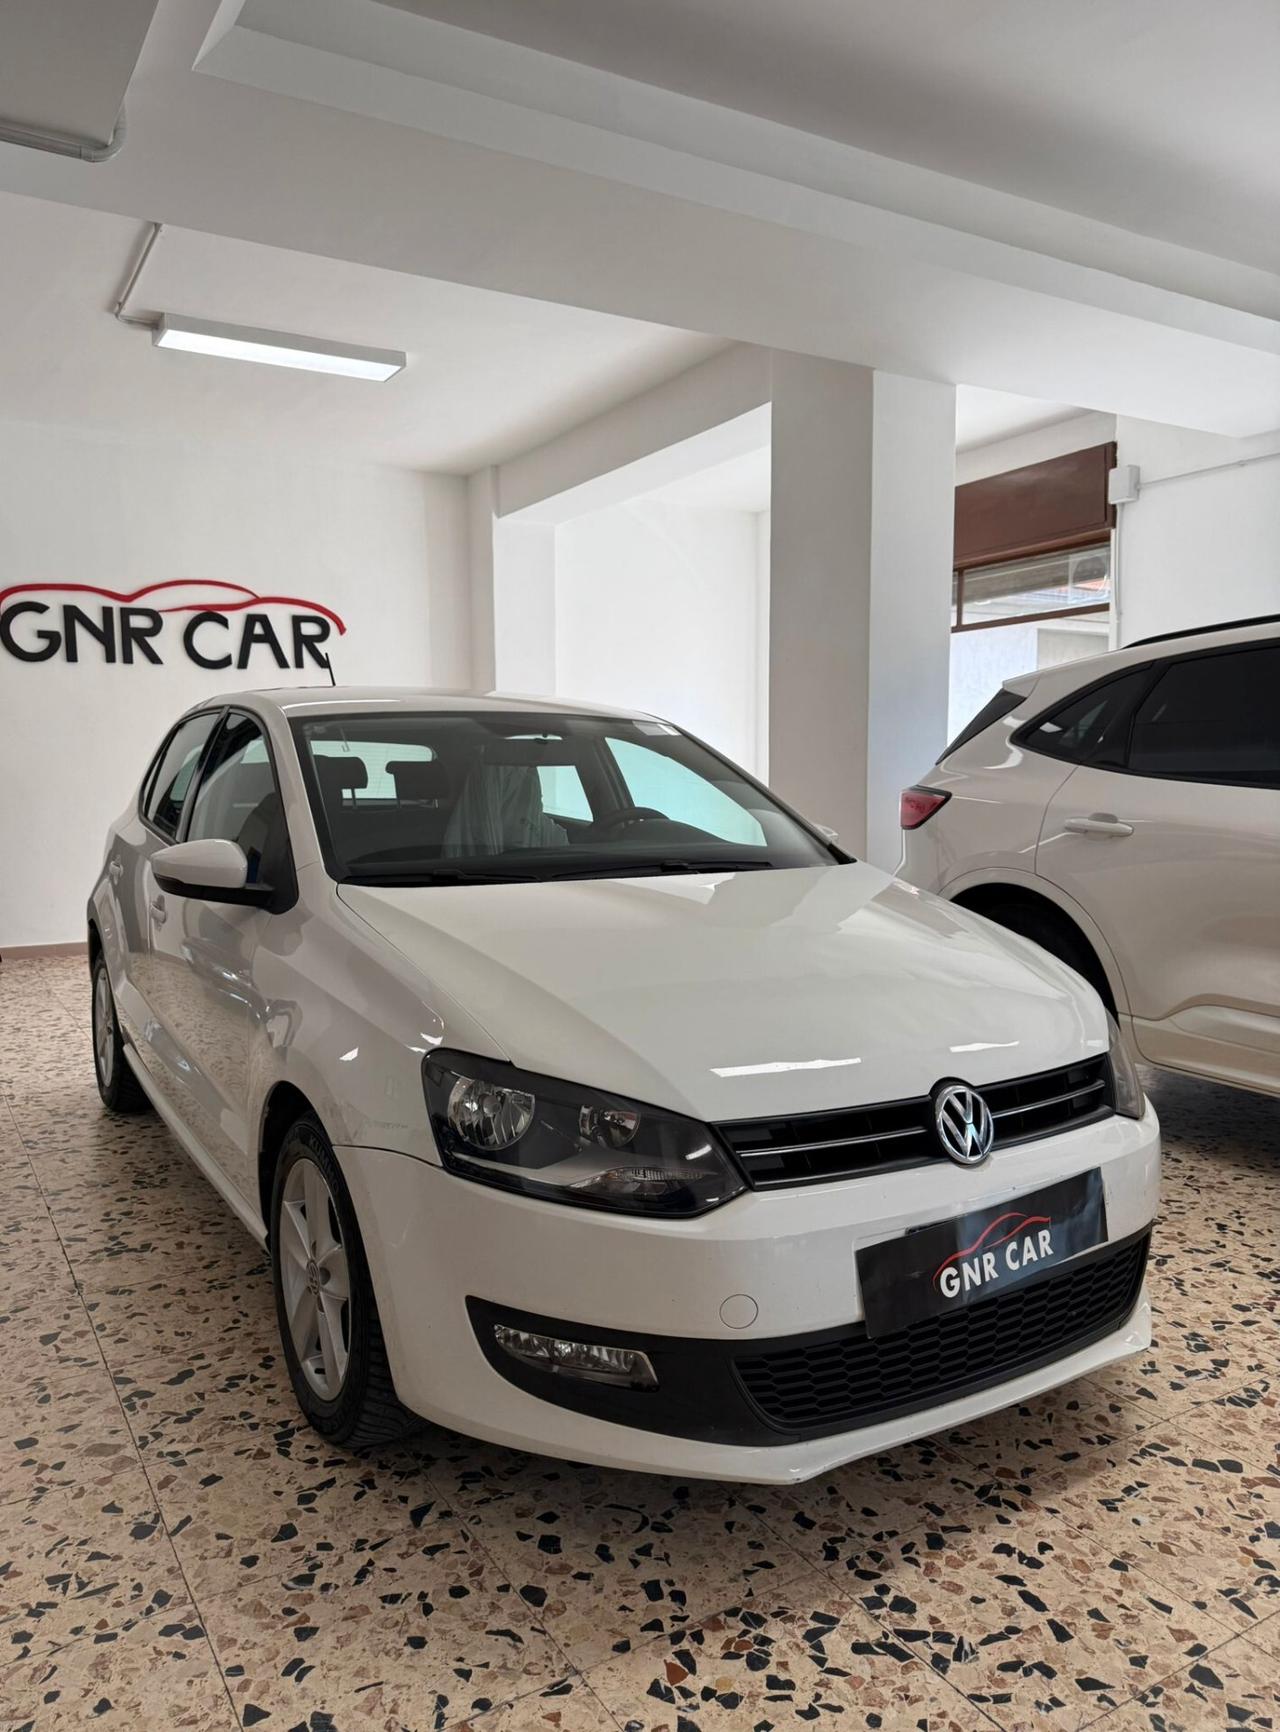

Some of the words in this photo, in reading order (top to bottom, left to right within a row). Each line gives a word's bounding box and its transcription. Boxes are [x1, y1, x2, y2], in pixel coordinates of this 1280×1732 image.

[0, 601, 164, 665] GNR
[183, 611, 331, 670] CAR
[939, 1252, 999, 1298] GNR
[1005, 1229, 1054, 1271] CAR
